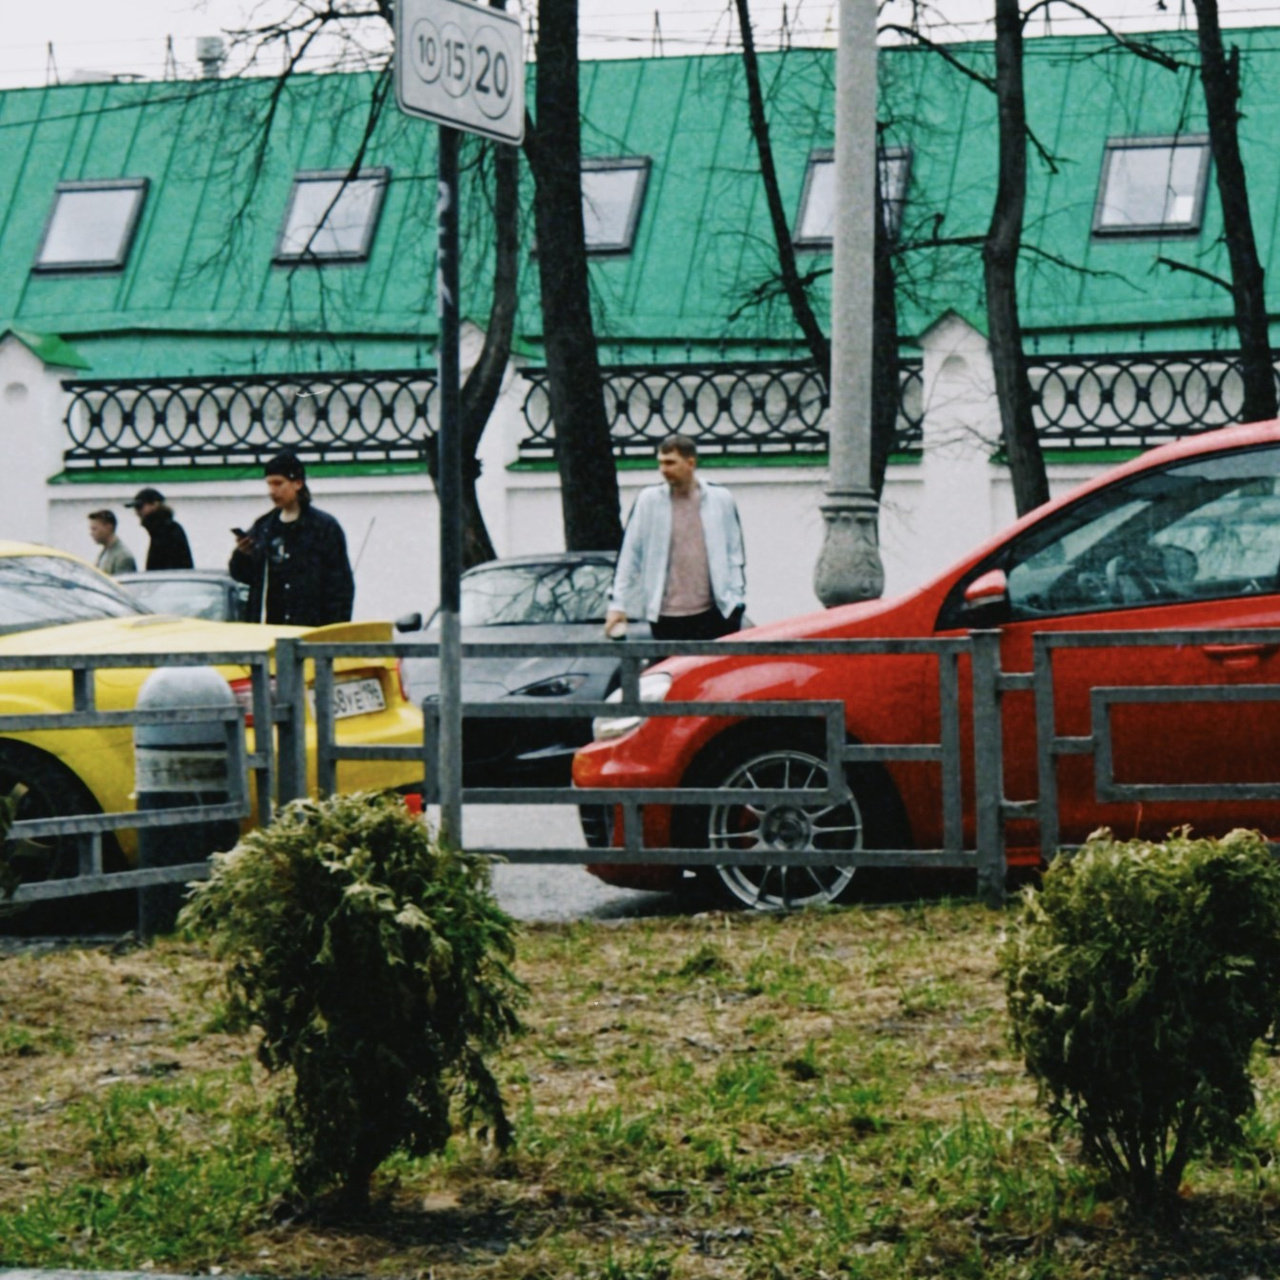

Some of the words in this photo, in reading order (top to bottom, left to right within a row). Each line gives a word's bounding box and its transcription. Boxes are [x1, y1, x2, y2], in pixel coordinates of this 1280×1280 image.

[418, 33, 437, 67] 10
[444, 38, 466, 81] 15
[475, 44, 509, 99] 20
